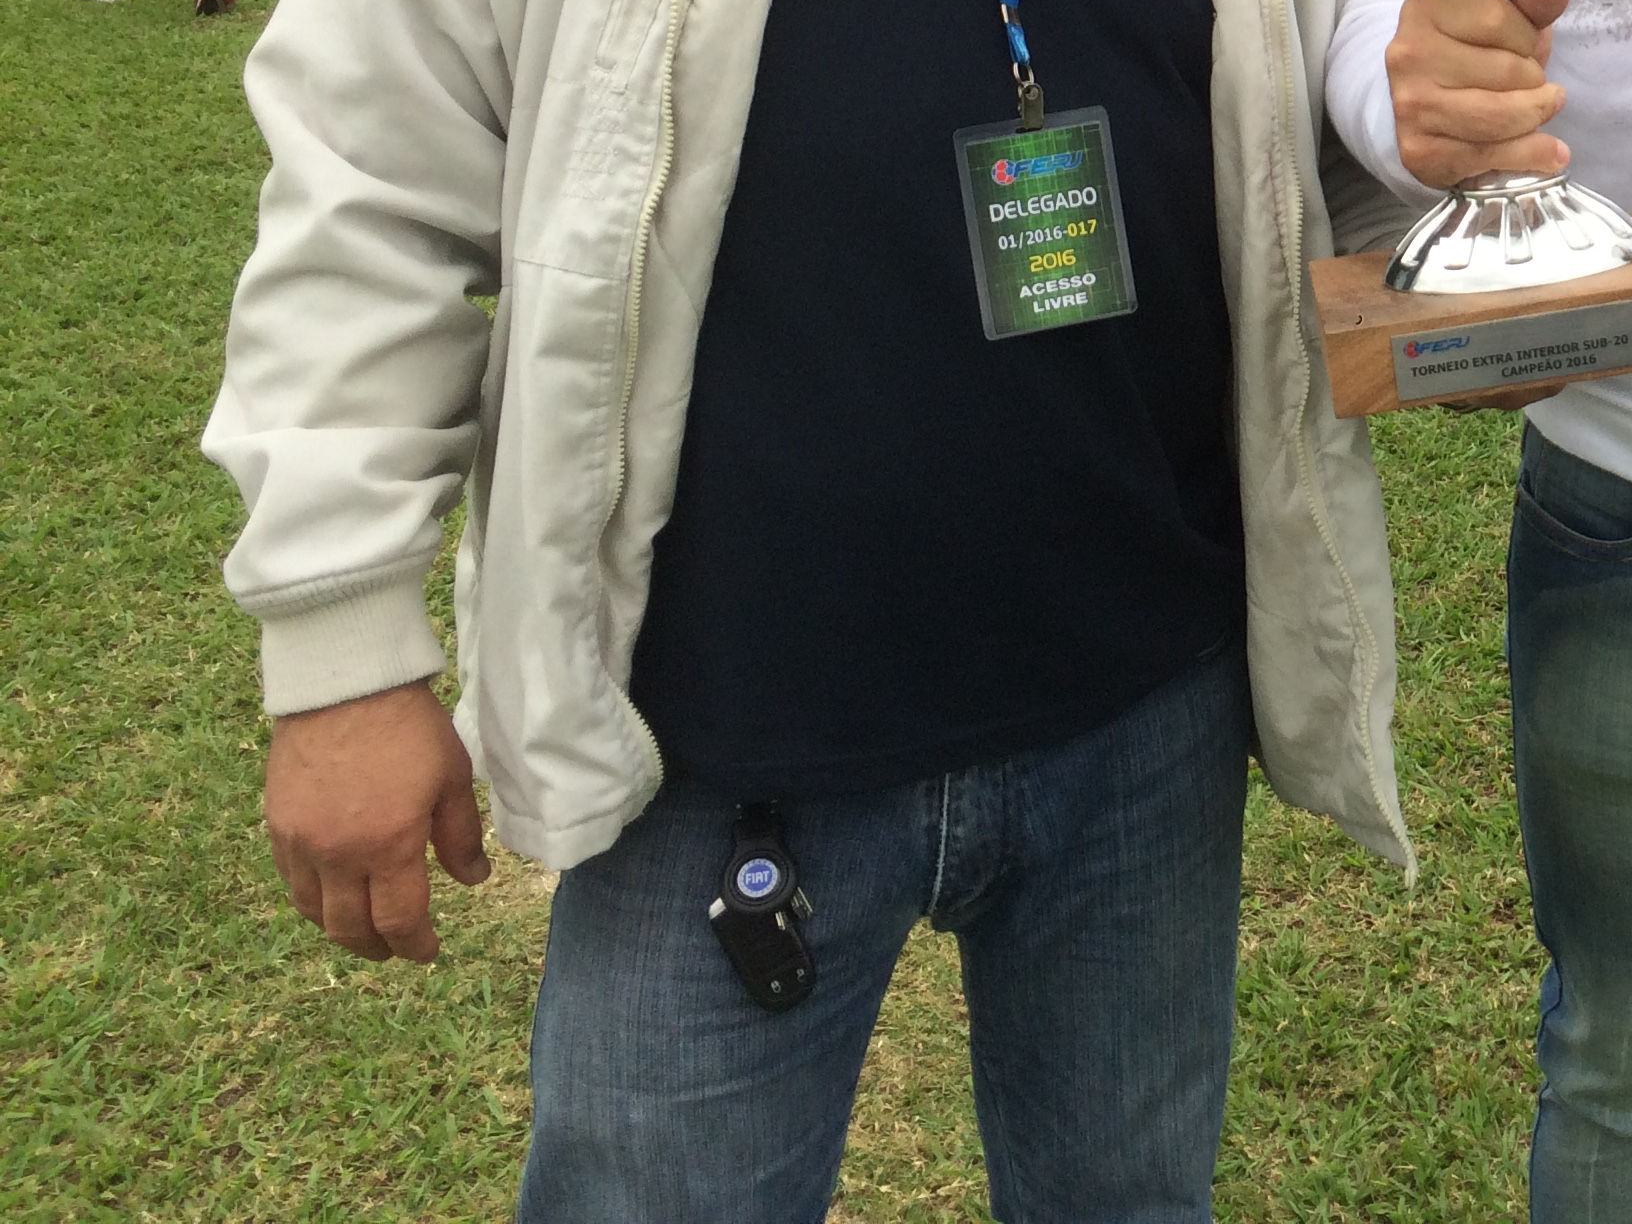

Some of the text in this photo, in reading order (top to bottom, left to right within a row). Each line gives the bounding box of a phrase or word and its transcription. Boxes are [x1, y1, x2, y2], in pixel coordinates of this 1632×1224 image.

[989, 186, 1098, 223] DELEGADO
[998, 219, 1098, 250] 01/2016-017
[1029, 249, 1077, 273] 2016
[1019, 272, 1097, 299] ACESSO
[1033, 291, 1089, 314] LIVRE
[1410, 360, 1469, 378] TORNEIO
[1473, 352, 1513, 368] EXTRA
[1516, 342, 1581, 362] INTERIOR
[1583, 334, 1629, 351] SUB-20
[1501, 354, 1597, 378] CAMPEÃO 2016
[745, 870, 770, 885] FIAT
